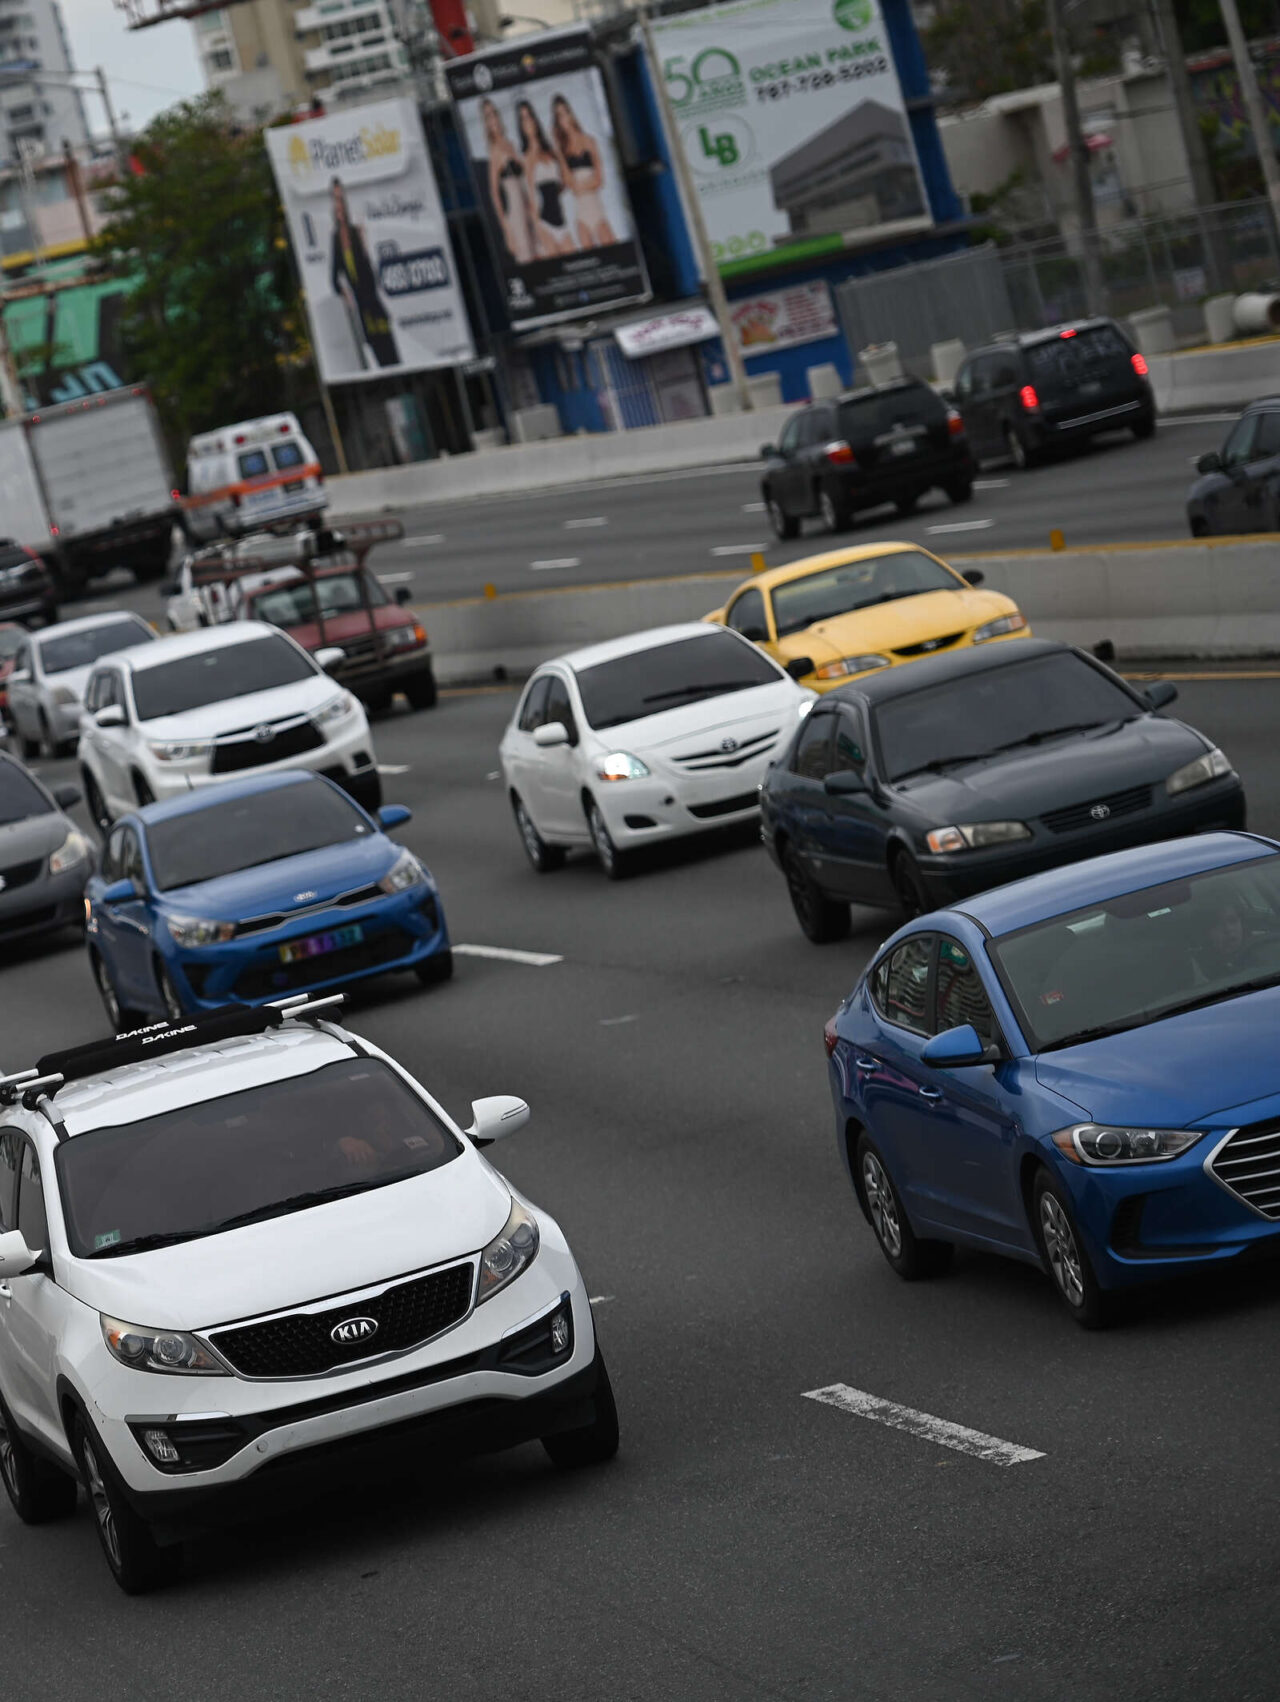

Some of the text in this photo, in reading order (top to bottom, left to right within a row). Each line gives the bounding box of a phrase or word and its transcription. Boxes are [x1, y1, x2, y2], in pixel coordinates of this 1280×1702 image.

[749, 37, 881, 83] OCEAN PARK
[115, 1021, 170, 1041] DAKINE
[141, 1024, 198, 1045] DAKINE
[338, 1321, 372, 1341] KIA
